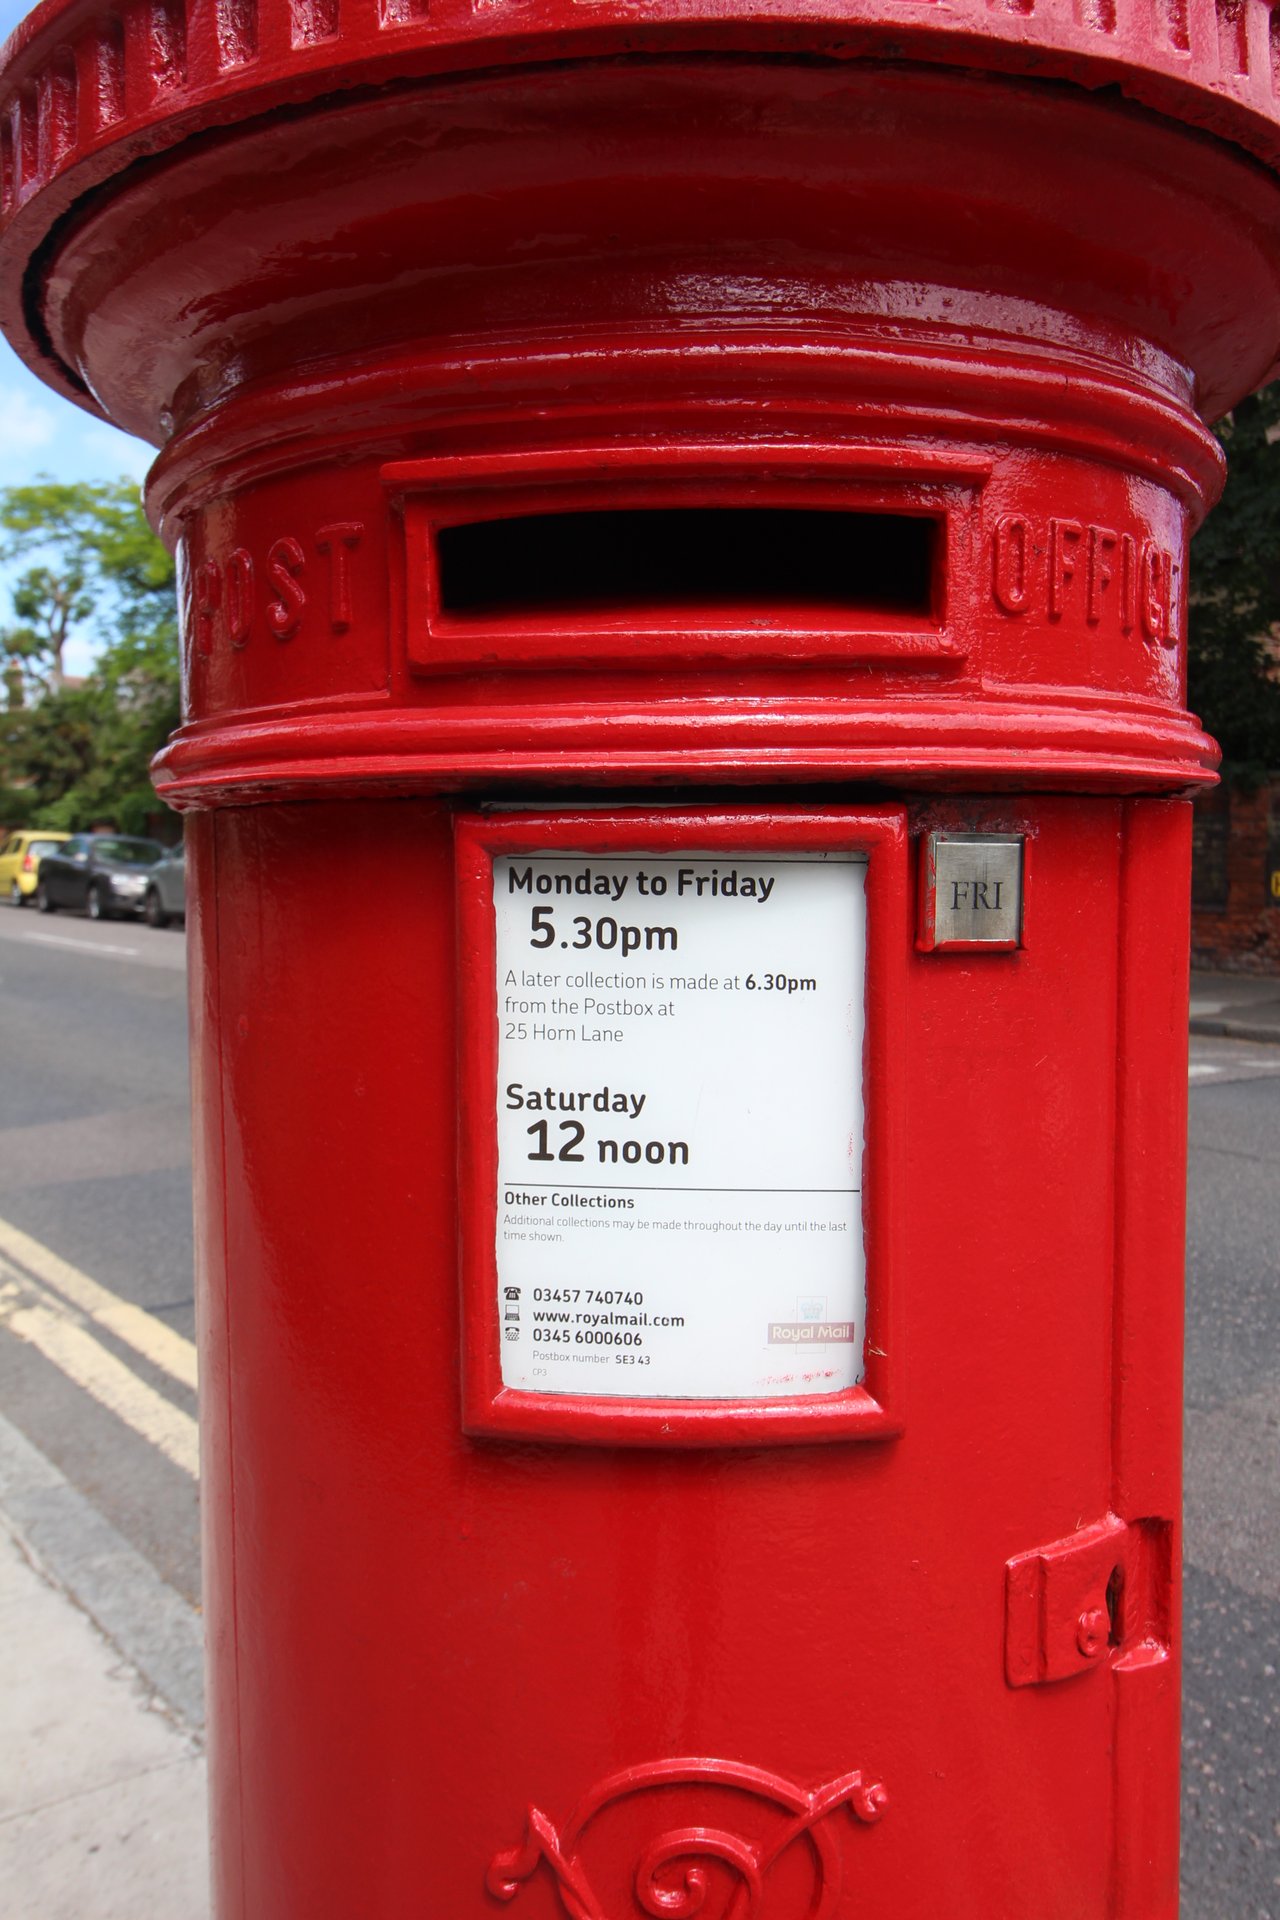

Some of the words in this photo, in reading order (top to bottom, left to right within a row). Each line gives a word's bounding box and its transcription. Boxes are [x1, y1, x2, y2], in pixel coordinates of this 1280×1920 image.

[507, 867, 628, 901] Monday
[636, 869, 667, 896] to
[676, 869, 775, 903] Friday
[950, 881, 1004, 910] FRI
[530, 906, 677, 957] 5.30pm
[505, 970, 516, 986] A
[522, 970, 561, 987] later
[566, 972, 646, 988] collection
[653, 973, 664, 989] is
[670, 974, 718, 990] made
[724, 976, 740, 990] at
[746, 974, 816, 994] 6.30pm
[505, 996, 545, 1013] from
[552, 998, 578, 1014] the
[585, 998, 653, 1015] Postbox
[658, 1002, 674, 1016] at
[506, 1023, 527, 1039] 25
[534, 1024, 575, 1040] Horn
[582, 1025, 623, 1042] Lane
[505, 1083, 647, 1118] Saturday
[527, 1119, 585, 1162] 12
[598, 1140, 688, 1165] noon
[505, 1192, 547, 1205] Other
[552, 1193, 634, 1208] Collections
[504, 1214, 554, 1225] Additional
[557, 1217, 610, 1228] collections
[612, 1218, 635, 1230] may
[638, 1219, 649, 1229] be
[653, 1220, 681, 1230] made
[684, 1220, 742, 1232] throughout
[745, 1221, 761, 1231] the
[764, 1221, 782, 1233] day
[785, 1222, 807, 1231] until
[810, 1222, 826, 1231] the
[829, 1222, 848, 1231] last
[504, 1230, 526, 1240] time
[529, 1231, 564, 1241] shown.
[534, 1288, 580, 1302] 03457
[586, 1290, 643, 1305] 740740
[532, 1310, 685, 1327] www.royalmail.com
[533, 1329, 570, 1343] 0345
[575, 1331, 642, 1346] 6000606
[773, 1325, 814, 1341] Royal
[818, 1325, 850, 1338] Mail
[533, 1350, 570, 1361] Postbox
[573, 1354, 610, 1363] number
[616, 1355, 635, 1364] SE3
[638, 1356, 650, 1365] 43
[533, 1368, 547, 1376] CP3
